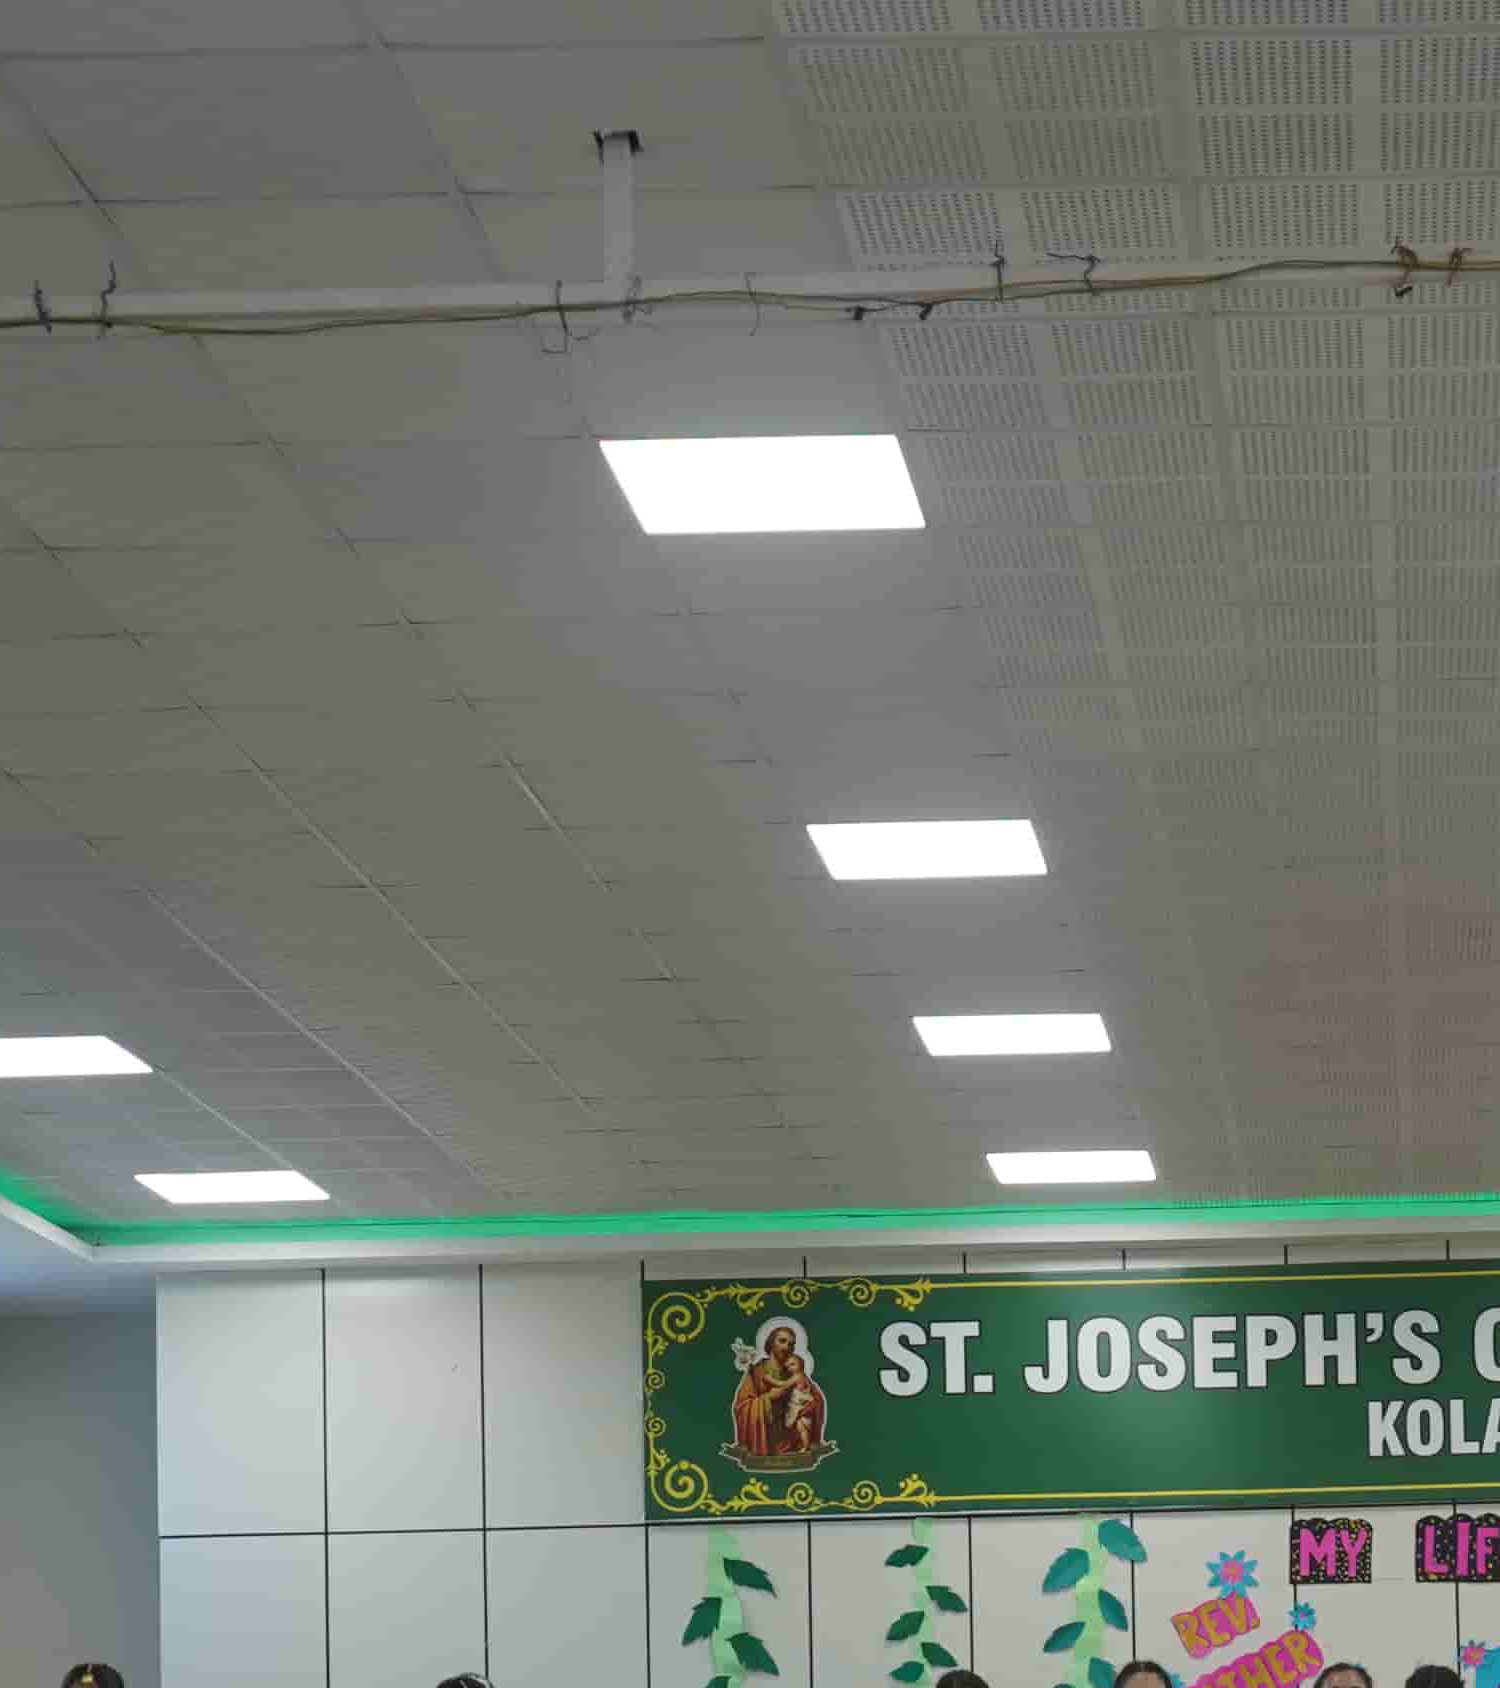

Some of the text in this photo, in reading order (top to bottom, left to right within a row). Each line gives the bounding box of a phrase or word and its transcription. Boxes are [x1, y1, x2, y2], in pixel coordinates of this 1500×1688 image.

[879, 1320, 994, 1396] ST.
[1023, 1309, 1442, 1393] JOSEPH'S
[1299, 1527, 1368, 1577] MY
